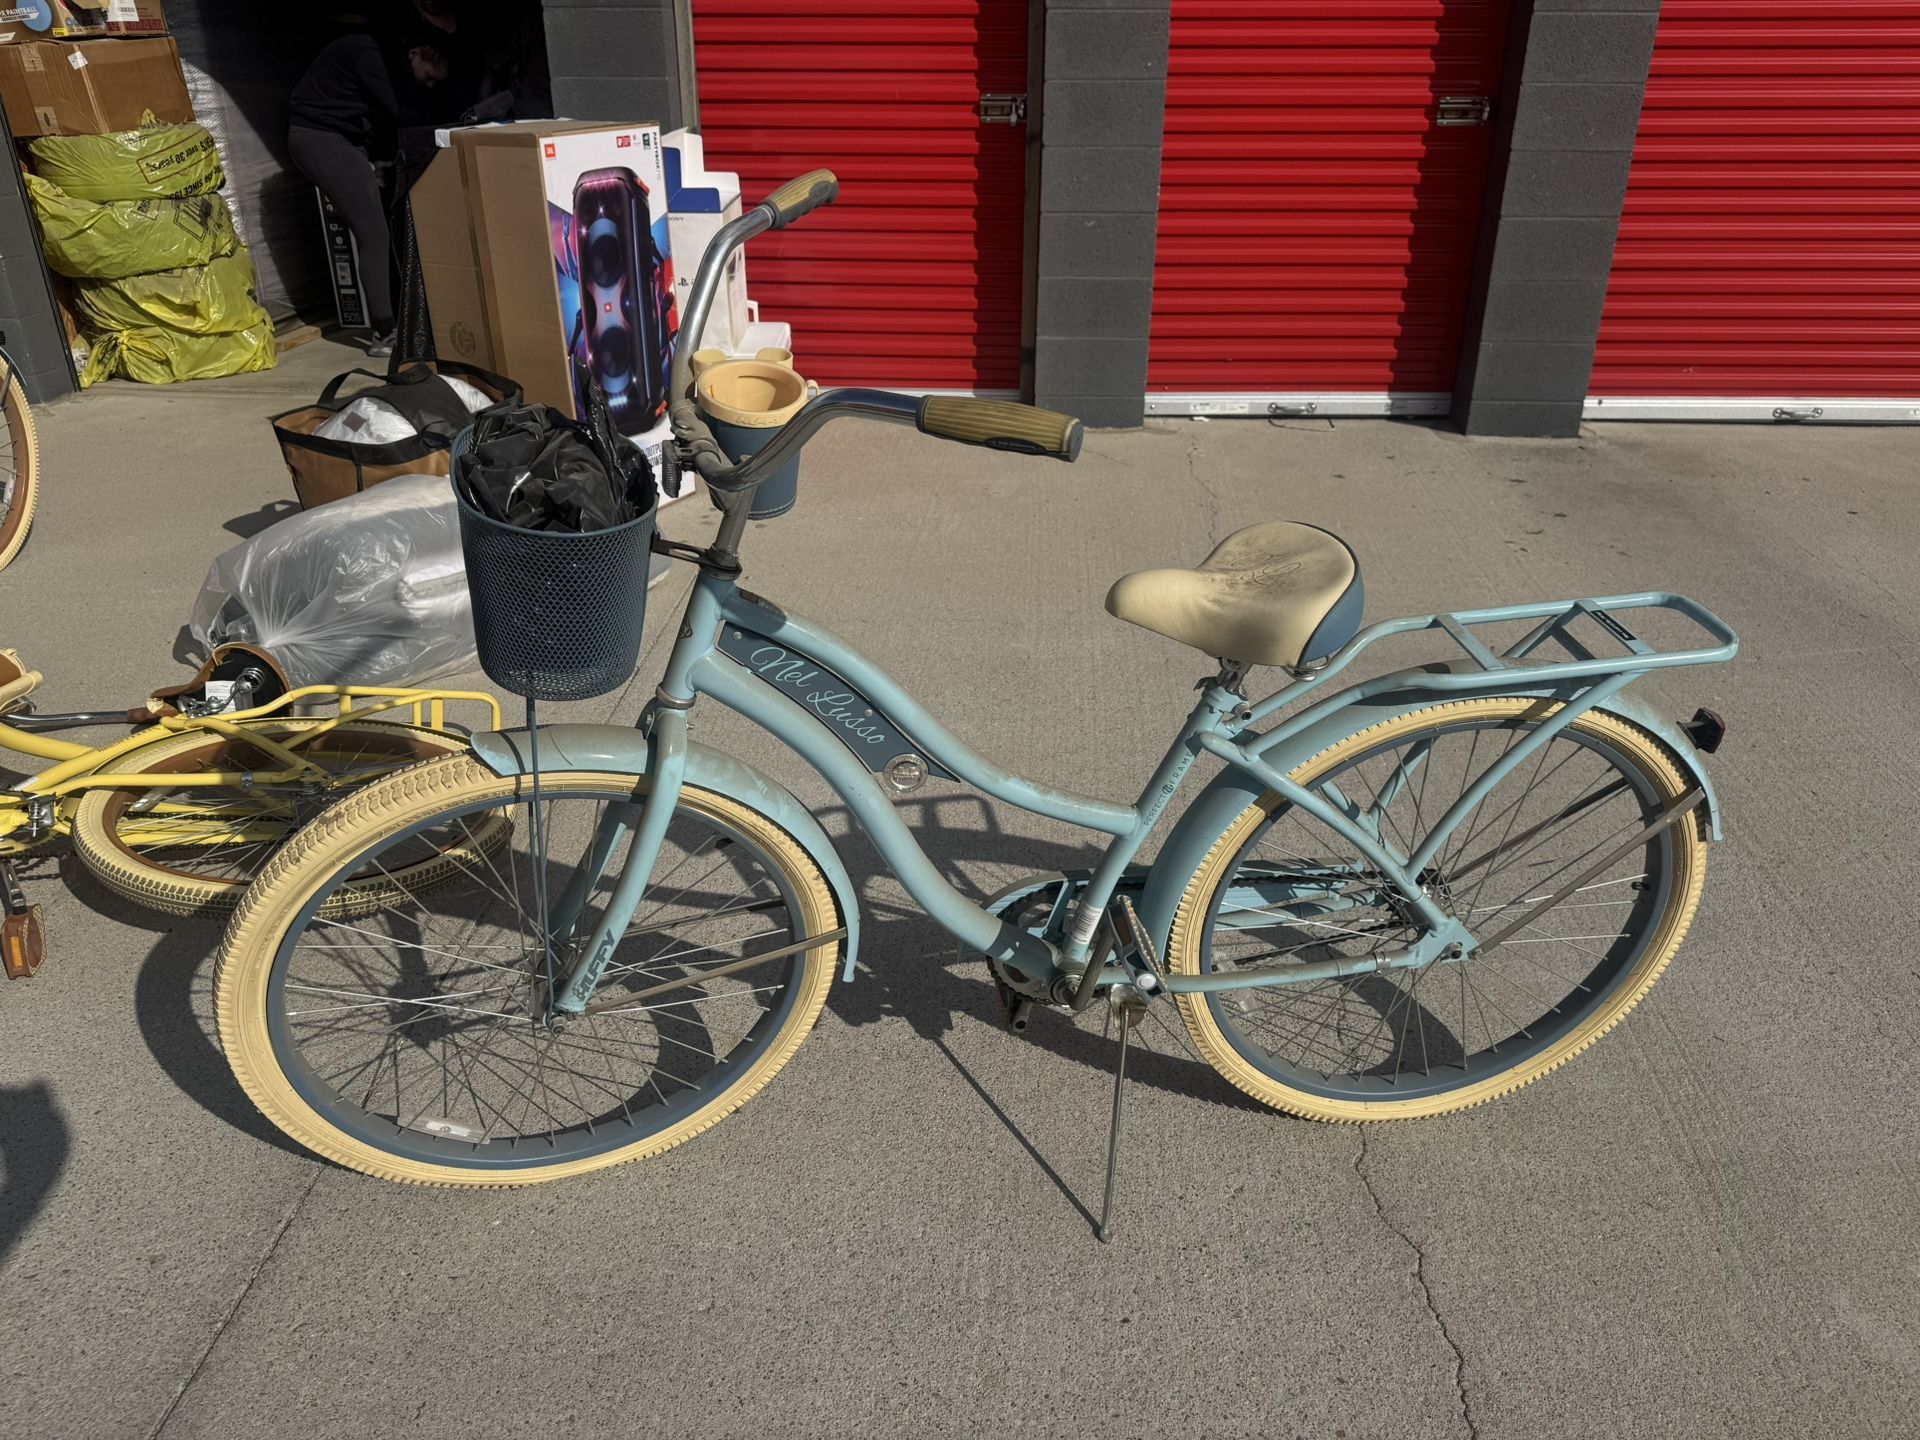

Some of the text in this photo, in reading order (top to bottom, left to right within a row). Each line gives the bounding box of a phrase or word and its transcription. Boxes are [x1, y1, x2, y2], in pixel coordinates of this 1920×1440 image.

[175, 153, 186, 163] 30
[750, 646, 886, 745] Nel Lusso
[1144, 752, 1193, 825] PERFECT FRAME
[572, 928, 616, 1001] HUFFY
